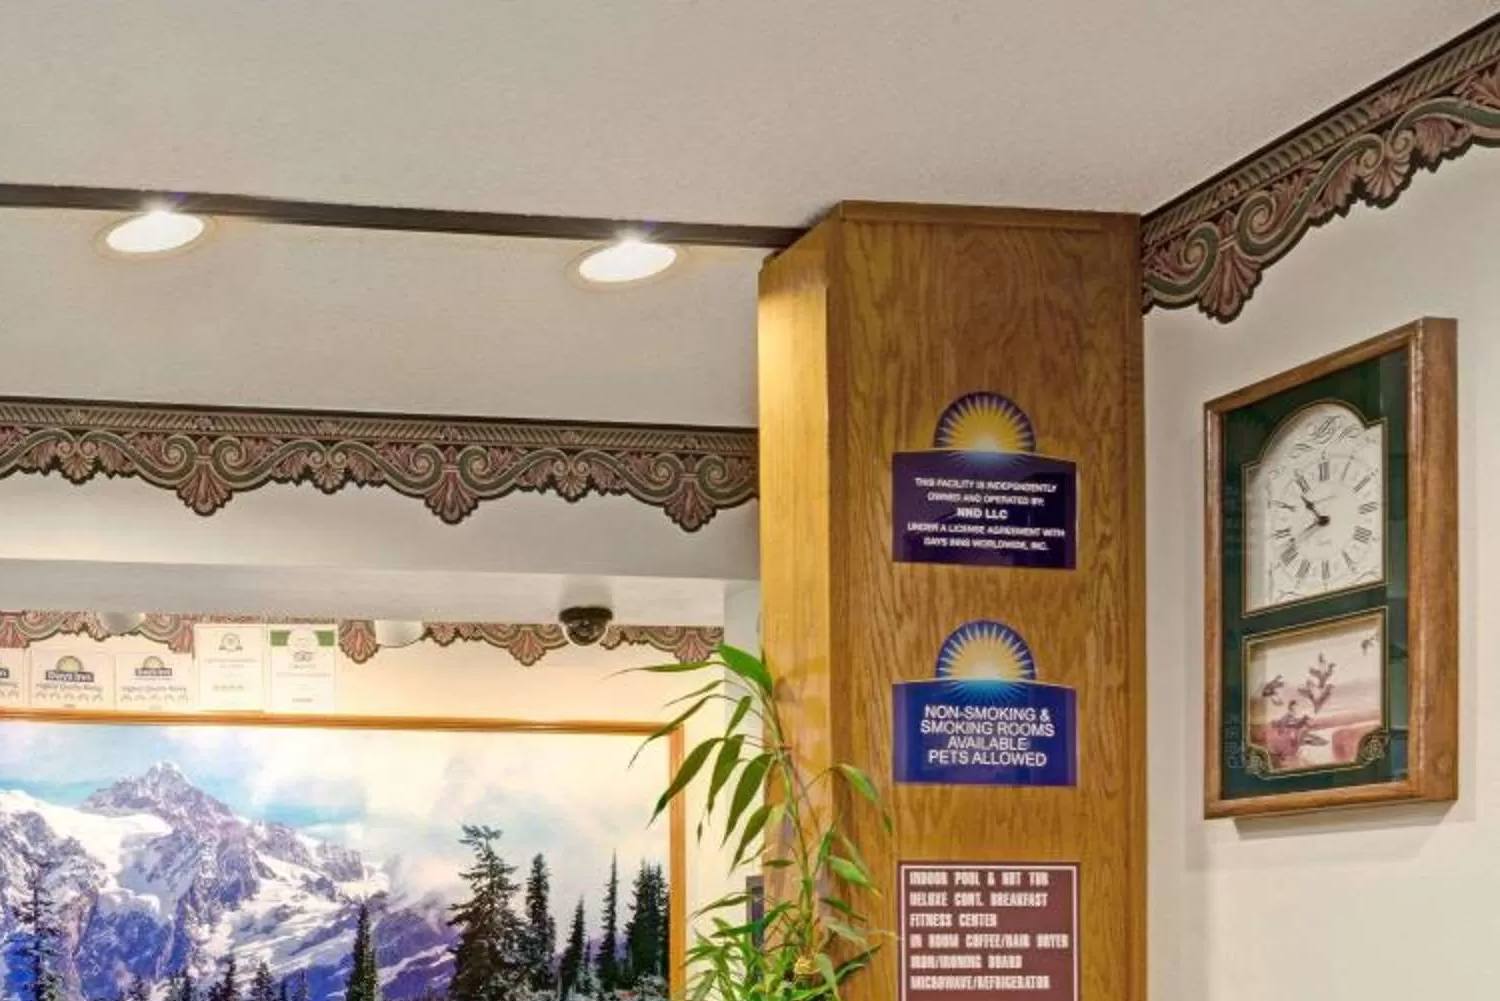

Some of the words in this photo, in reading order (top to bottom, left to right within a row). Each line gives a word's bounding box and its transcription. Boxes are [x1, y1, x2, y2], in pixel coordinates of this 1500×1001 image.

[936, 479, 975, 489] FACILITY
[963, 493, 981, 503] AND
[983, 495, 1030, 505] OPERATED
[985, 508, 1009, 520] LLC
[907, 521, 939, 532] UNDER
[940, 523, 947, 532] A
[949, 523, 986, 534] LICENSE
[987, 525, 1042, 537] AGREEMENT
[1042, 527, 1066, 538] WITH
[923, 536, 948, 546] DAYS
[924, 703, 1037, 722] NON-SMOKING
[1039, 707, 1052, 723] &
[919, 720, 994, 736] SMOKING
[996, 721, 1056, 738] ROOMS
[947, 736, 1029, 752] AVAILABLE
[928, 749, 970, 765] PETS
[971, 750, 1048, 768] ALLOWED
[954, 871, 981, 886] POOL
[987, 871, 996, 886] &
[1001, 871, 1022, 886] HOT
[908, 891, 949, 907] DELUXE
[989, 891, 1049, 907] BREAKFAST
[909, 912, 953, 928] FITNESS
[958, 912, 998, 928] CENTER
[927, 933, 960, 949] ROOM
[965, 933, 1031, 949] COFFEE/HAIR
[1035, 933, 1070, 949] DRYER
[909, 974, 1051, 990] MICROWAVE/REFRIGERATOR
